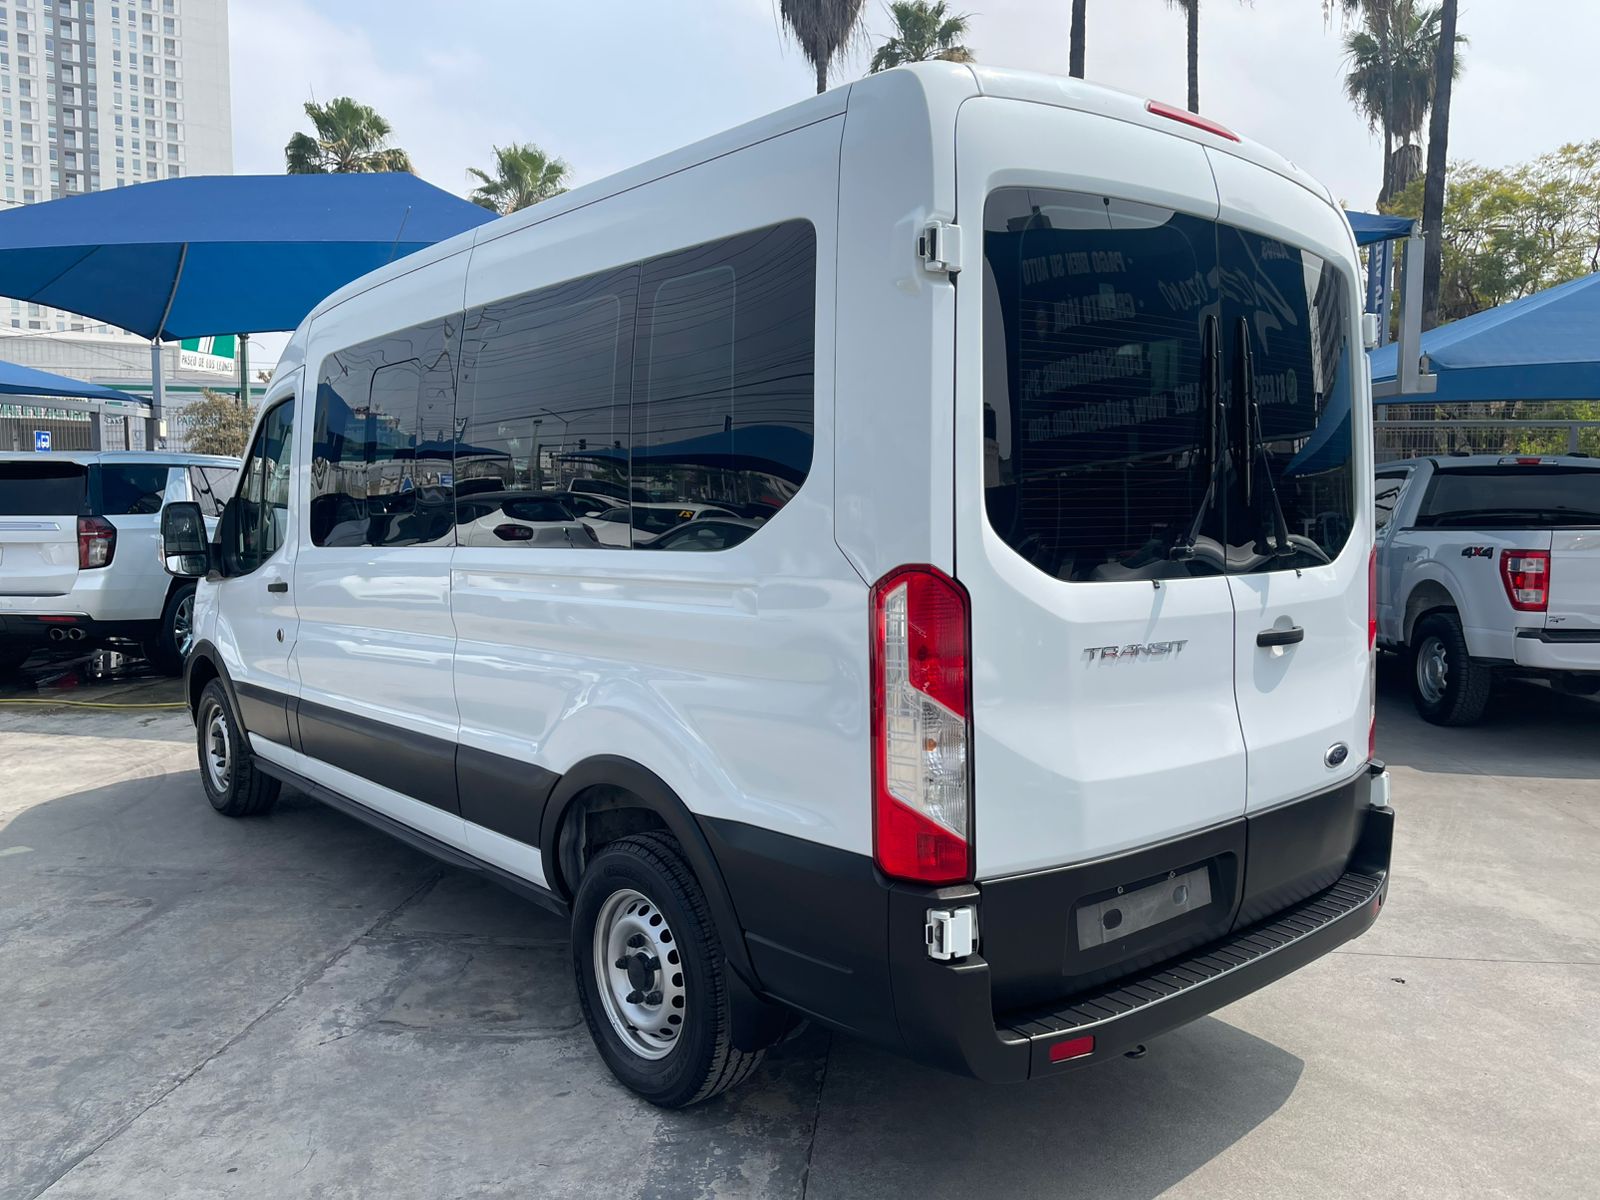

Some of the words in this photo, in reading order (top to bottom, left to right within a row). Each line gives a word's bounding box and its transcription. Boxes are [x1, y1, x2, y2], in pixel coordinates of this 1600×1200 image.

[1376, 240, 1384, 278] AUT
[182, 355, 197, 367] PASEO
[1084, 639, 1189, 661] TRANSIT
